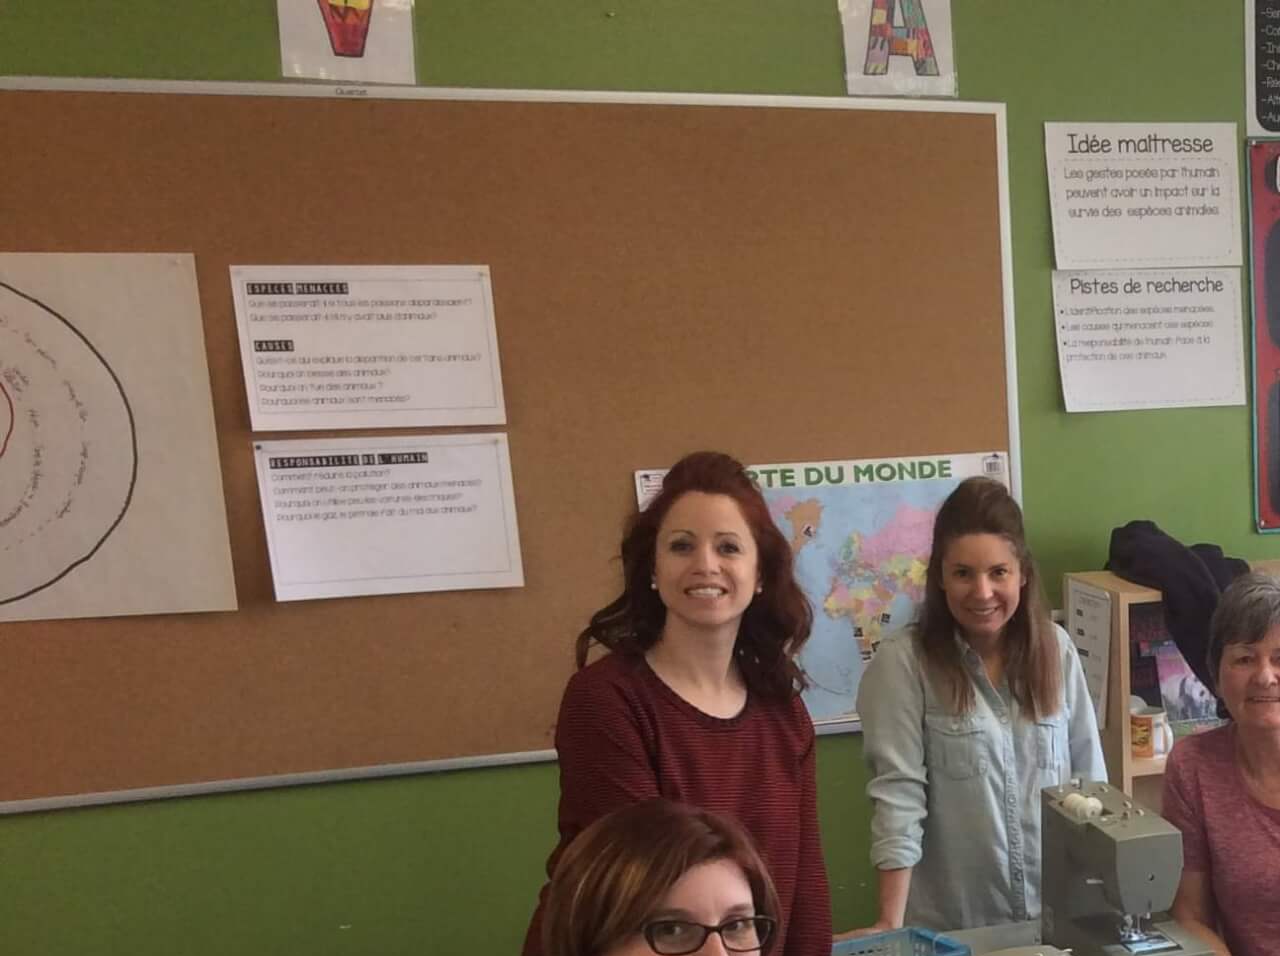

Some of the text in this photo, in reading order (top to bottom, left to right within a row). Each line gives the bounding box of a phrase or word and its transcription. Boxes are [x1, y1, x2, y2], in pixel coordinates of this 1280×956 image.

[1067, 133, 1112, 154] Idée
[1070, 276, 1224, 294] Pistes de recherche
[745, 460, 953, 488] RTE DU MONDE
